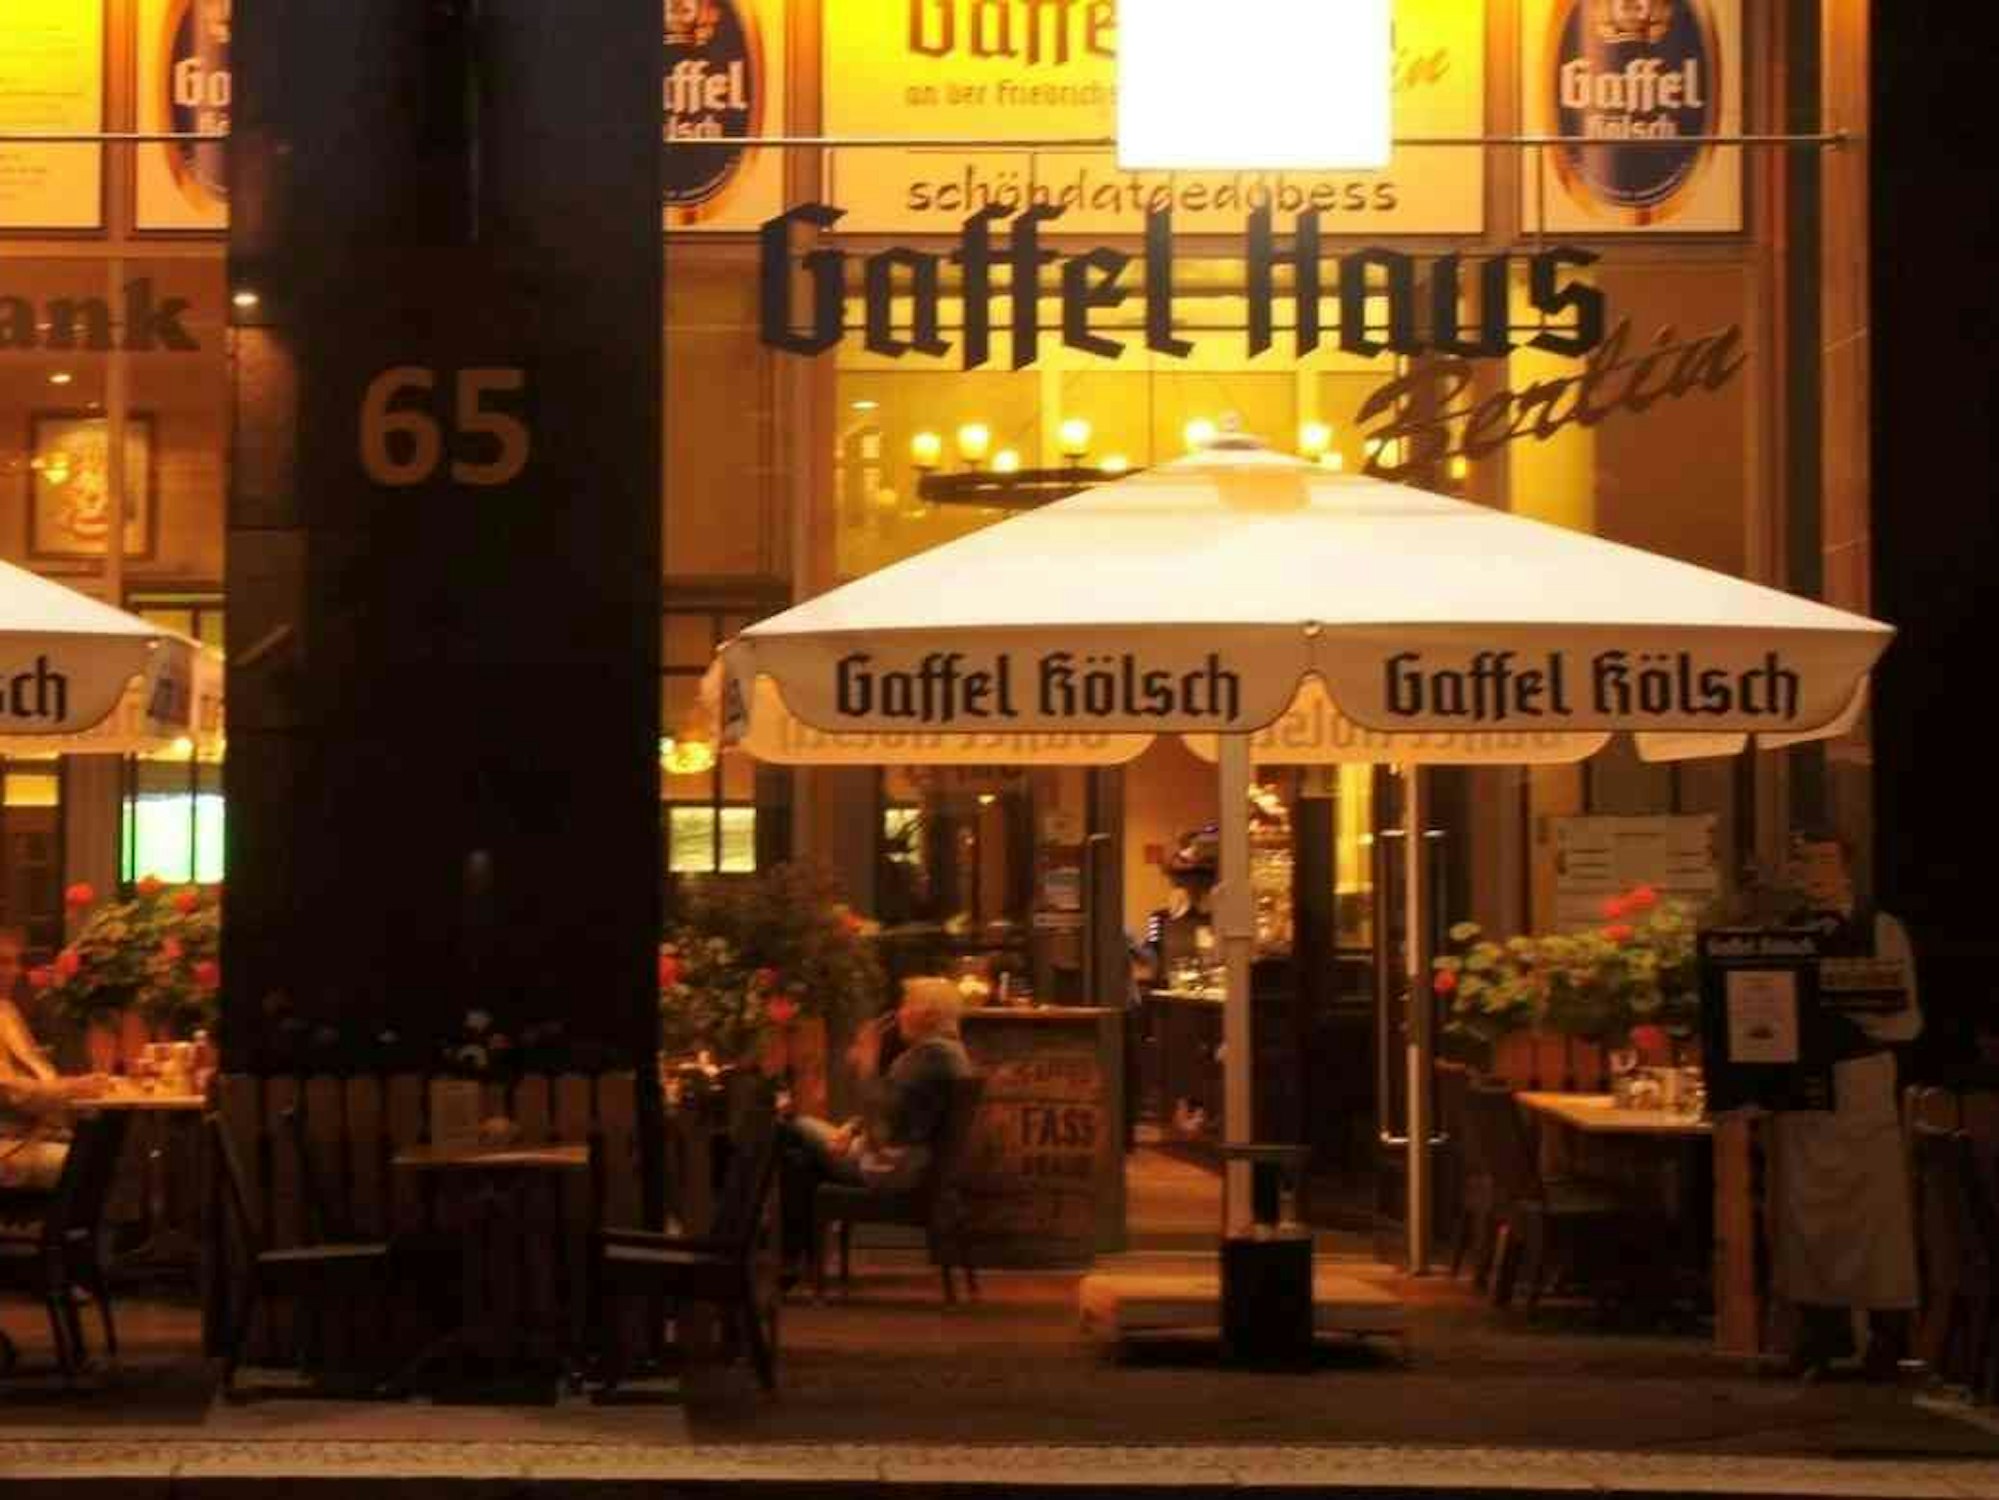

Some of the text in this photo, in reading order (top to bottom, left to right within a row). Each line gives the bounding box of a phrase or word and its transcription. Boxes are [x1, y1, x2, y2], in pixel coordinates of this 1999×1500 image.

[1560, 58, 1705, 112] Gaffel
[759, 201, 1606, 371] Gaffel Haus
[360, 366, 530, 486] 65
[1355, 316, 1748, 480] Berlin
[0, 655, 67, 722] ch
[836, 652, 1241, 723] Gaffel Kölsch
[1384, 650, 1799, 722] Gaffel Kölsch
[1021, 1107, 1096, 1147] FASS
